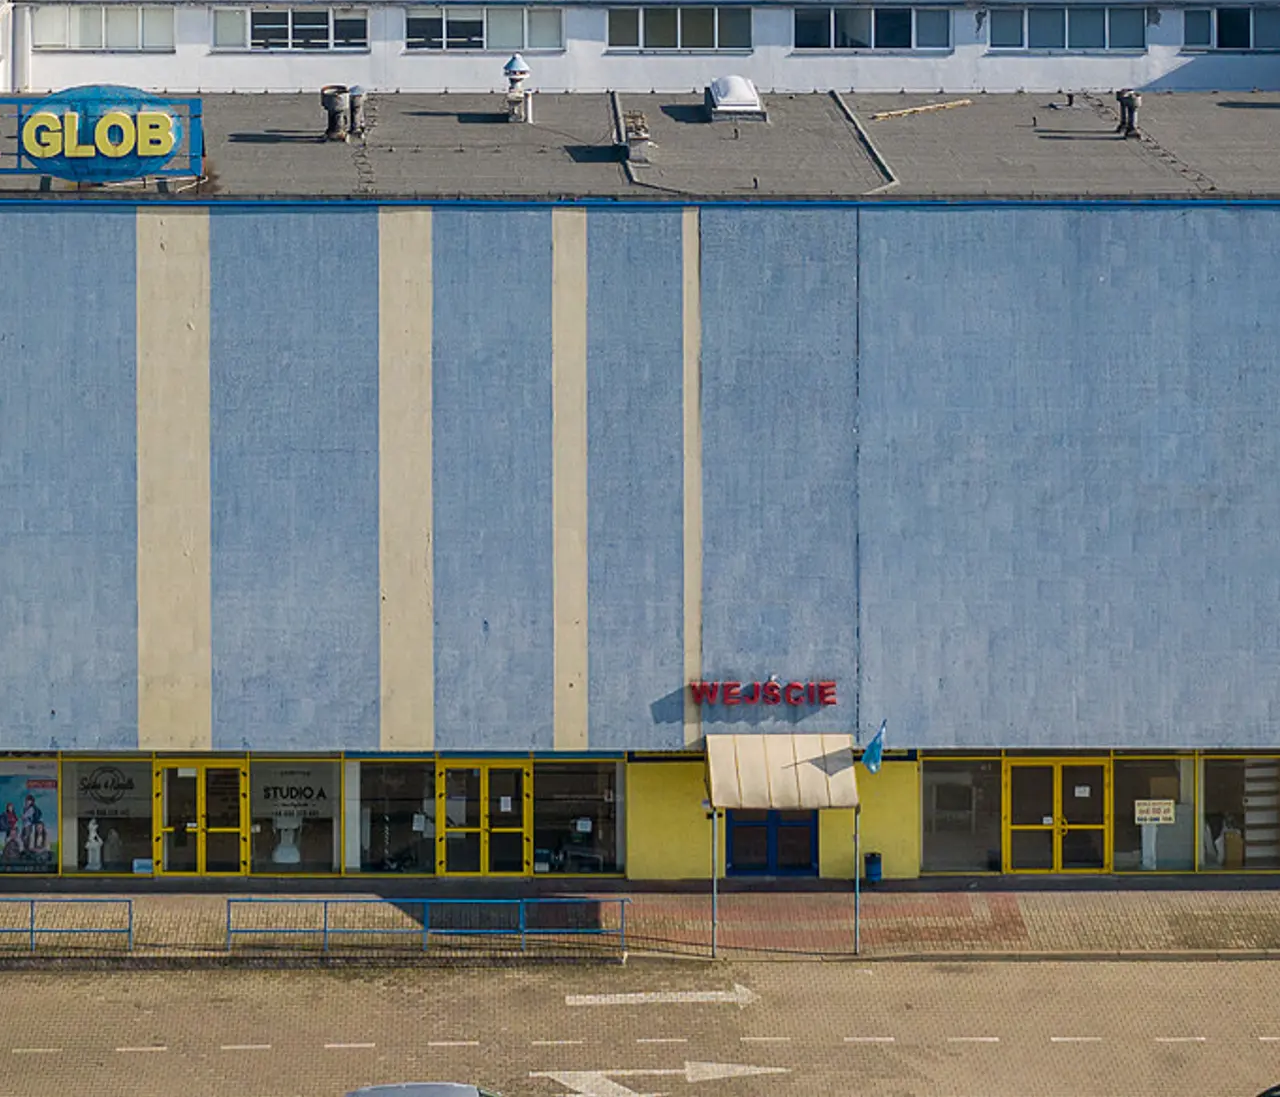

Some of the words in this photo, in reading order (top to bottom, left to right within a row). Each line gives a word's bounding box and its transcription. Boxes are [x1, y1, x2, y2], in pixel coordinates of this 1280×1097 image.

[21, 111, 174, 158] GLOB
[689, 676, 838, 706] WEJŚCIE
[263, 786, 314, 799] STUDIO
[317, 786, 327, 800] A
